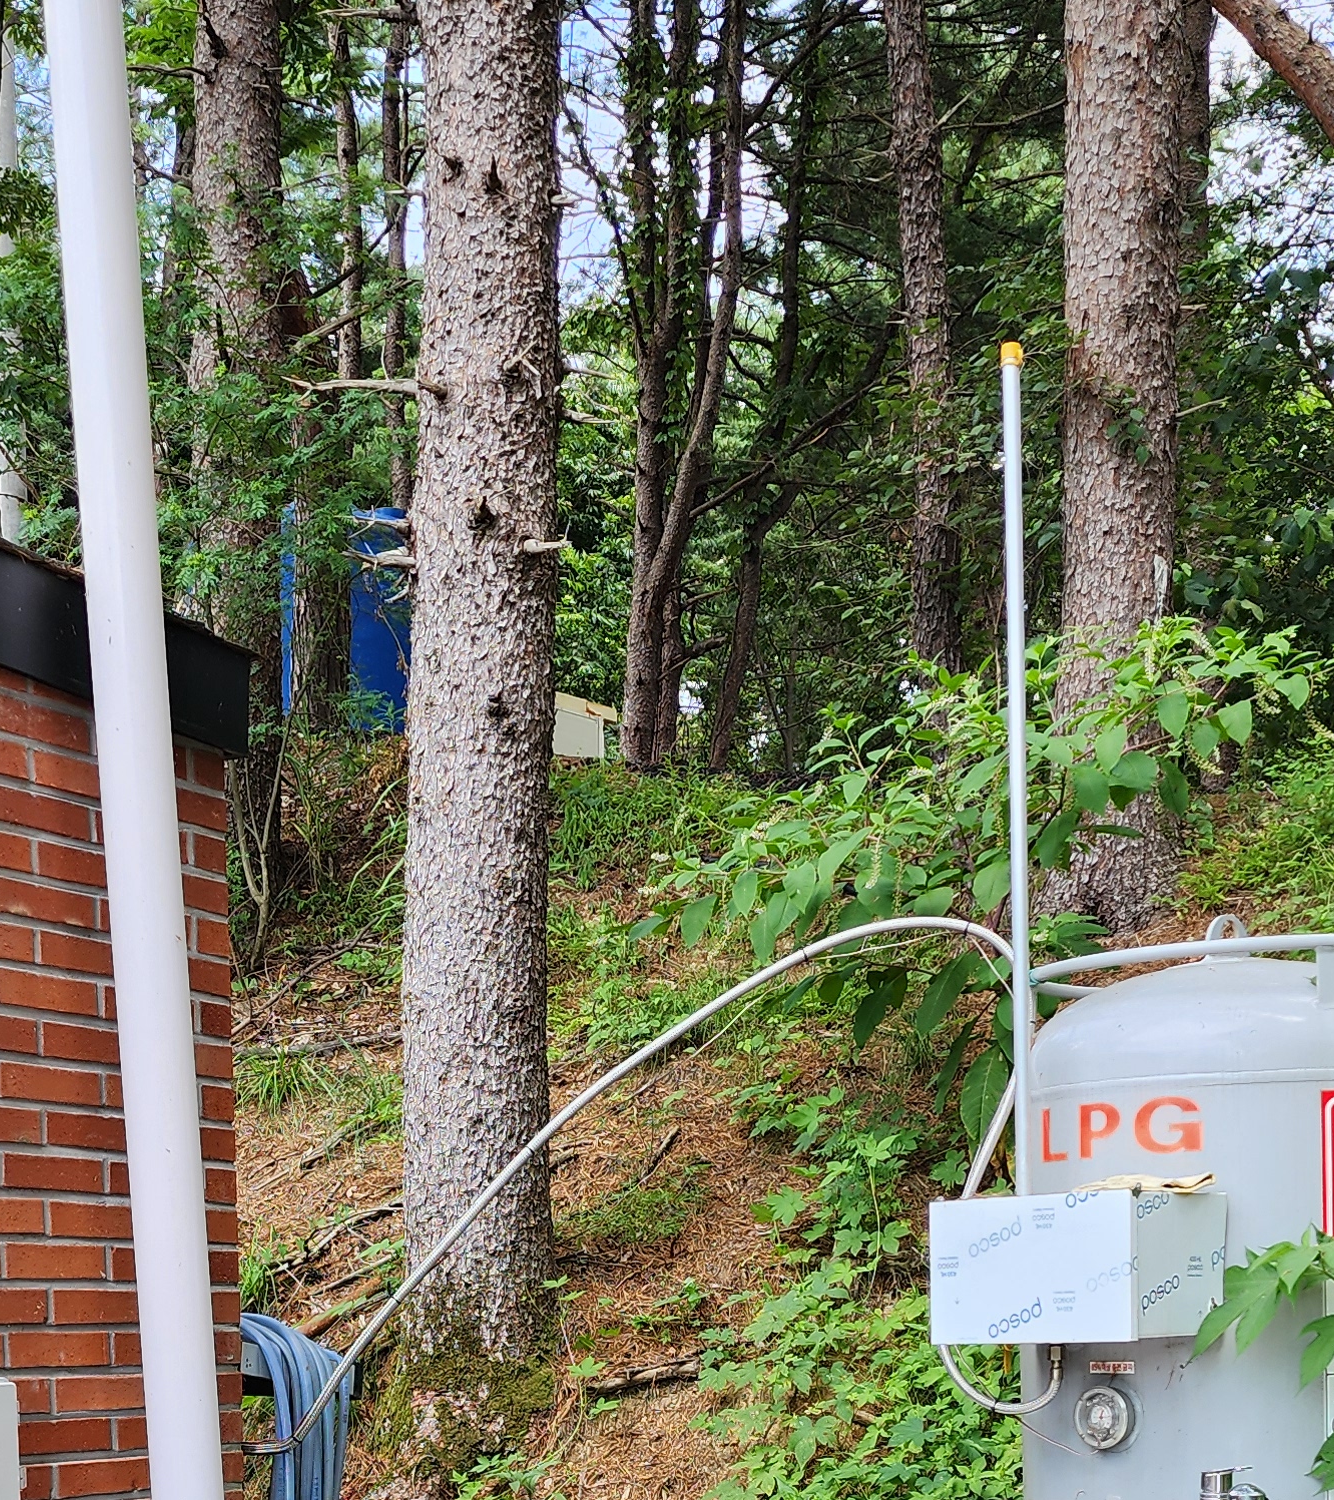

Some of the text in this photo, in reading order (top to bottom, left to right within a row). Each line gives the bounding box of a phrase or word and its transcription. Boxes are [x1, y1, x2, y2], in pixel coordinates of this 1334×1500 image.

[1042, 1095, 1204, 1162] LPG
[968, 1215, 1022, 1258] posco
[1141, 1275, 1180, 1316] posco
[988, 1297, 1043, 1339] posco
